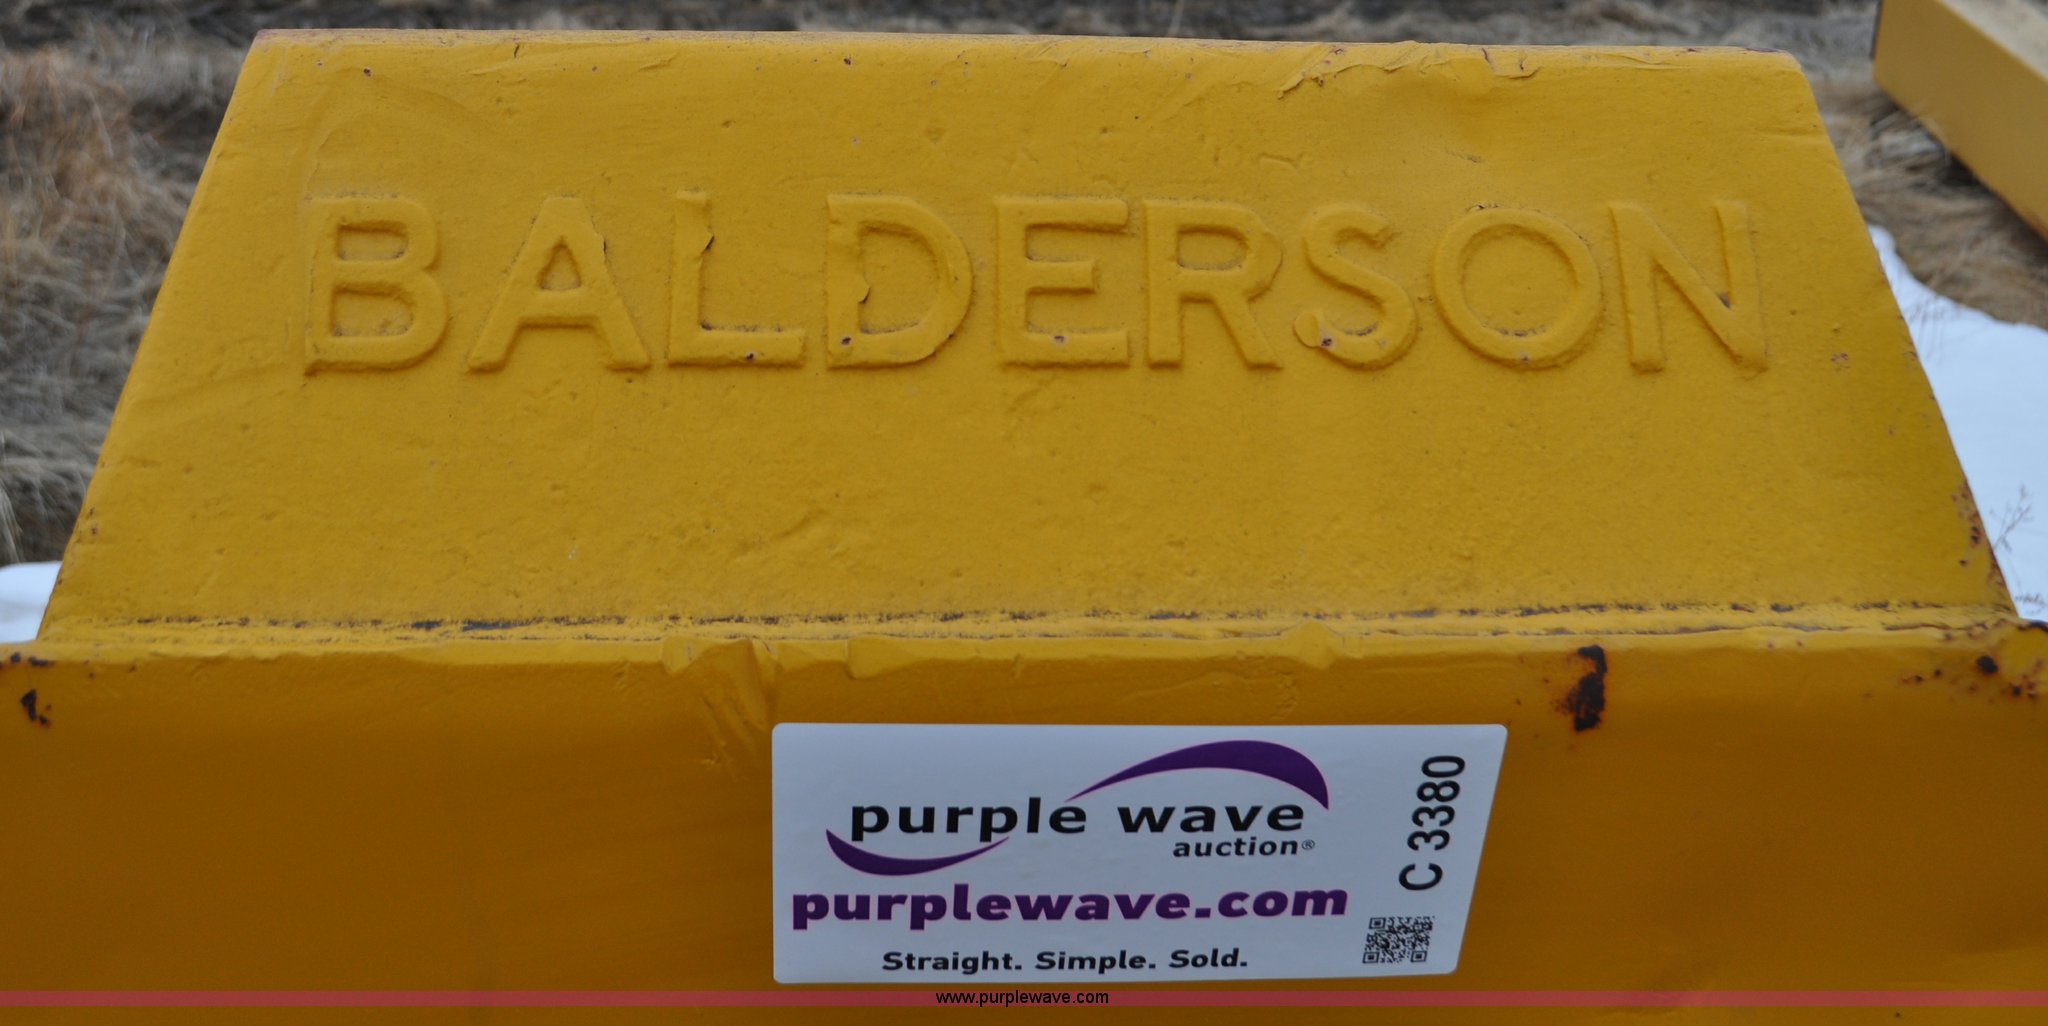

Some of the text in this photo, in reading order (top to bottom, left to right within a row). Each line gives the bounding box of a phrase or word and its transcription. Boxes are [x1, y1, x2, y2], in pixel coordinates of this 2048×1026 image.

[302, 190, 1770, 378] BALDERSON
[850, 797, 1305, 842] purple wave
[1399, 754, 1467, 892] C 3380
[791, 883, 1349, 932] purplewave.com
[882, 948, 1249, 976] Straight. Simple. Sold.
